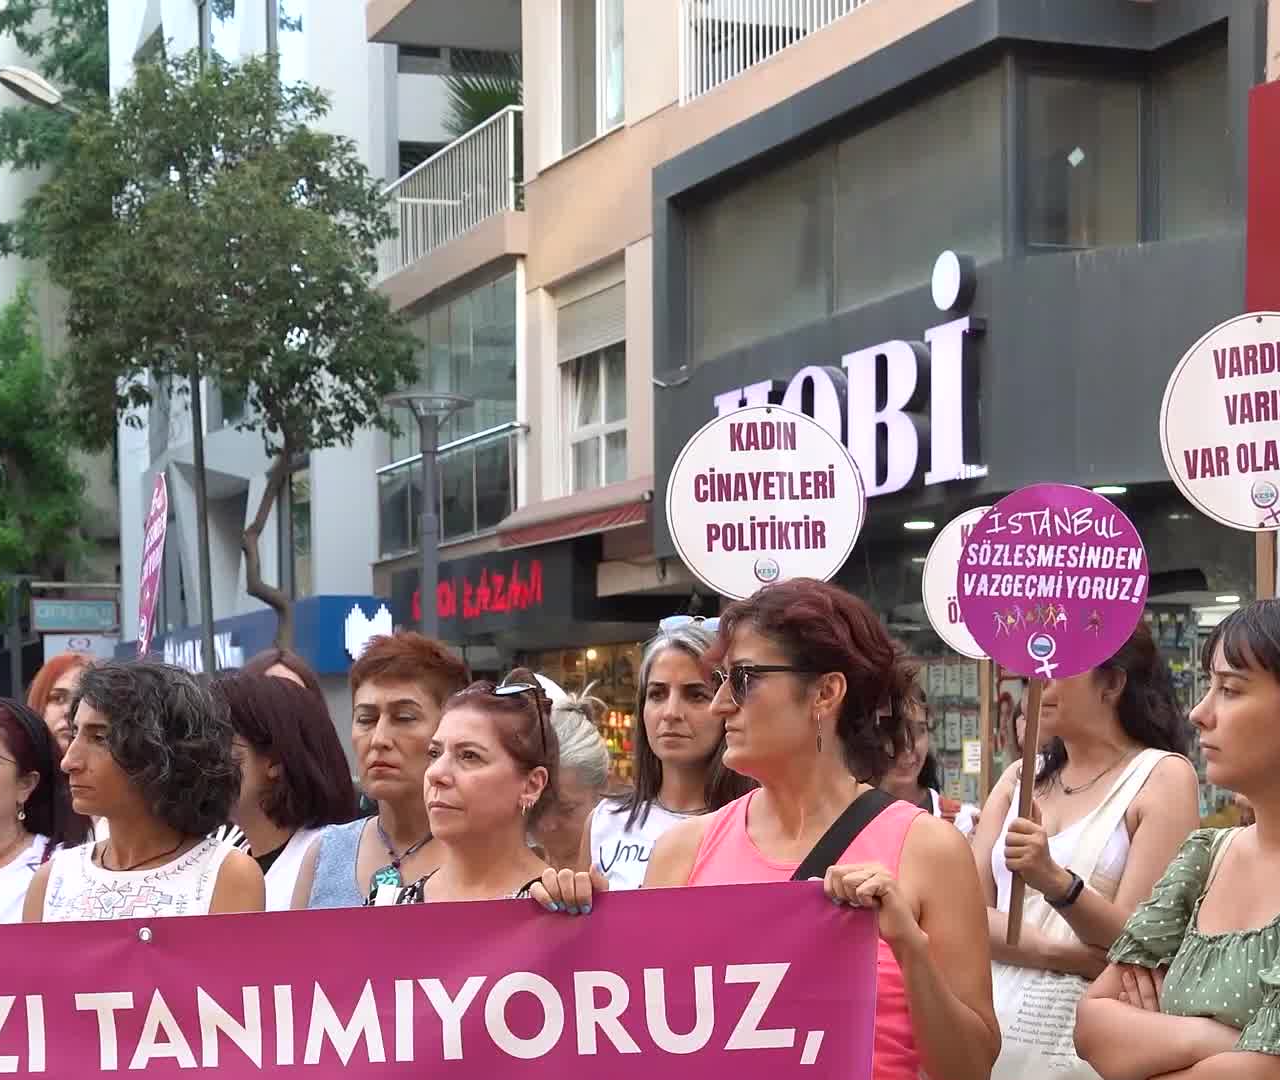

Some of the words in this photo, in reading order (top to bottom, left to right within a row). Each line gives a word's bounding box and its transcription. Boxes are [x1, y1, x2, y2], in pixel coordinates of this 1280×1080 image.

[729, 421, 797, 452] KADIN
[1184, 446, 1230, 481] VAR
[694, 464, 836, 503] CİNAYETLERİ
[706, 515, 827, 553] POLİTİKTİR
[985, 507, 1123, 539] İSTANBUL
[966, 540, 1143, 570] SÖZLEŞMESİNDEN
[963, 570, 1147, 604] VAZGEÇMİYORUZ!
[74, 962, 825, 1072] TANIMIYORUZ,
